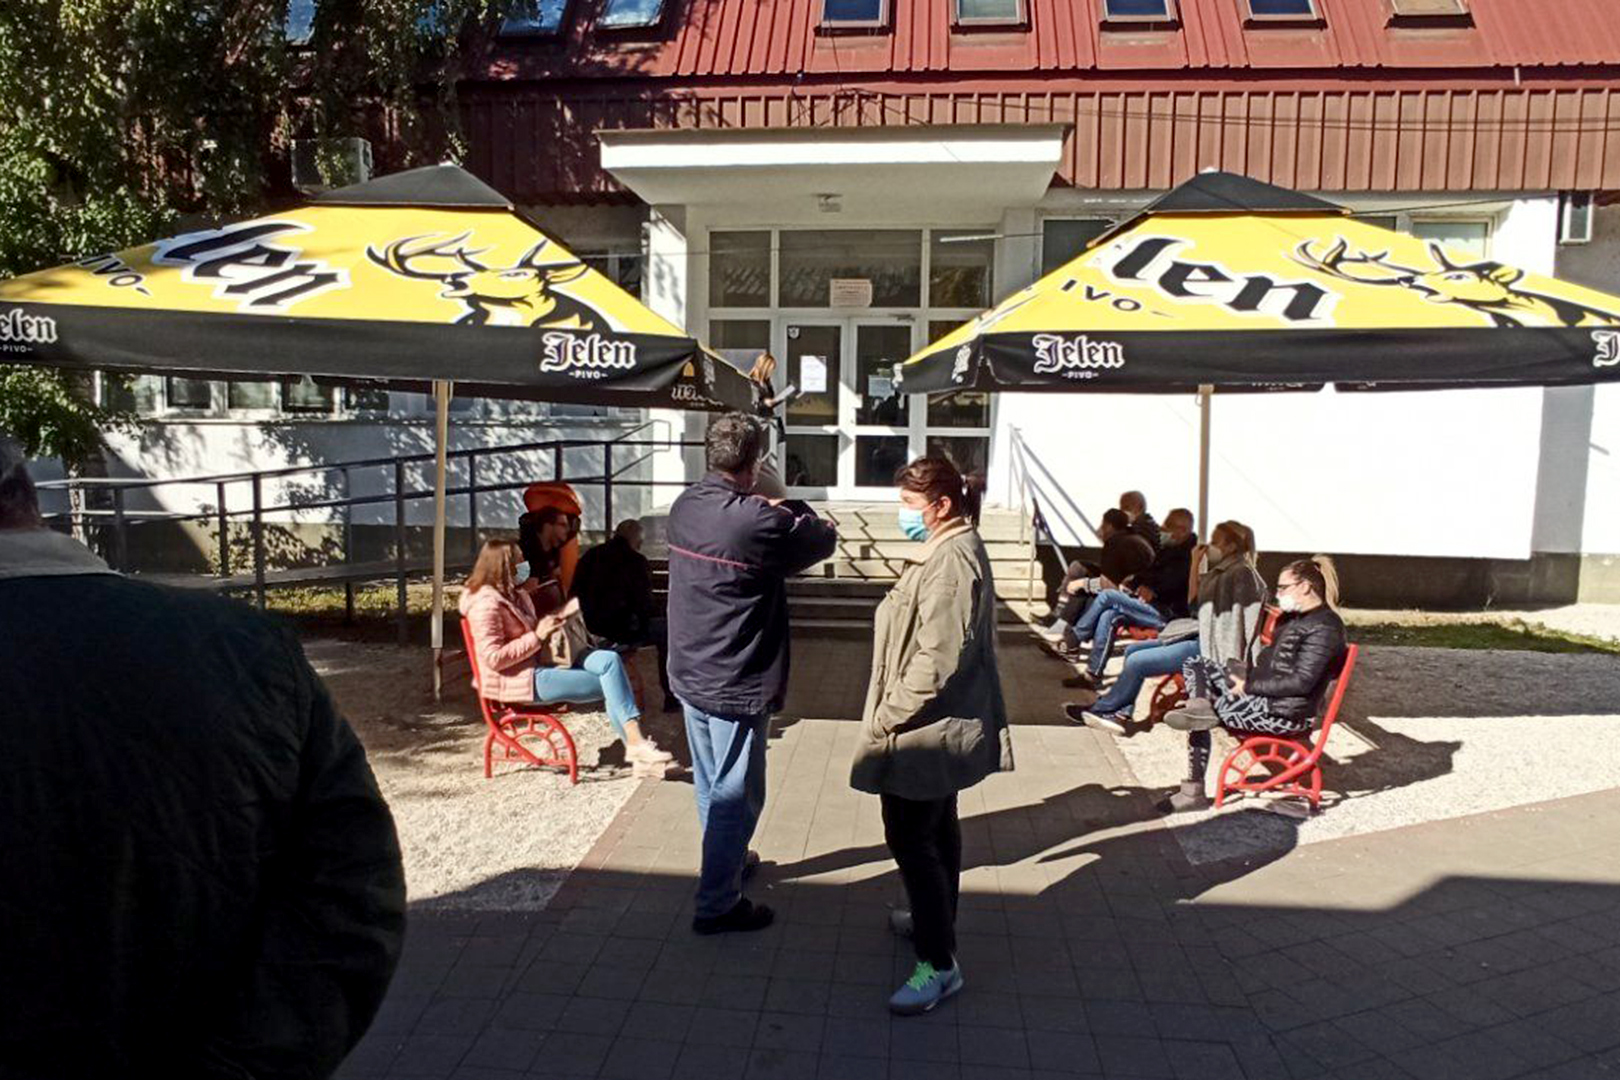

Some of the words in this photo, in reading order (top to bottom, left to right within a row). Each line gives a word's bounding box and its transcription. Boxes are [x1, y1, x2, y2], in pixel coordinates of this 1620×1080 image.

[78, 253, 145, 288] IVO
[158, 221, 346, 309] len
[1110, 236, 1330, 322] len
[1060, 279, 1142, 312] IVO
[0, 308, 58, 344] elen
[540, 331, 637, 372] Jelen
[1032, 333, 1125, 373] Jelen
